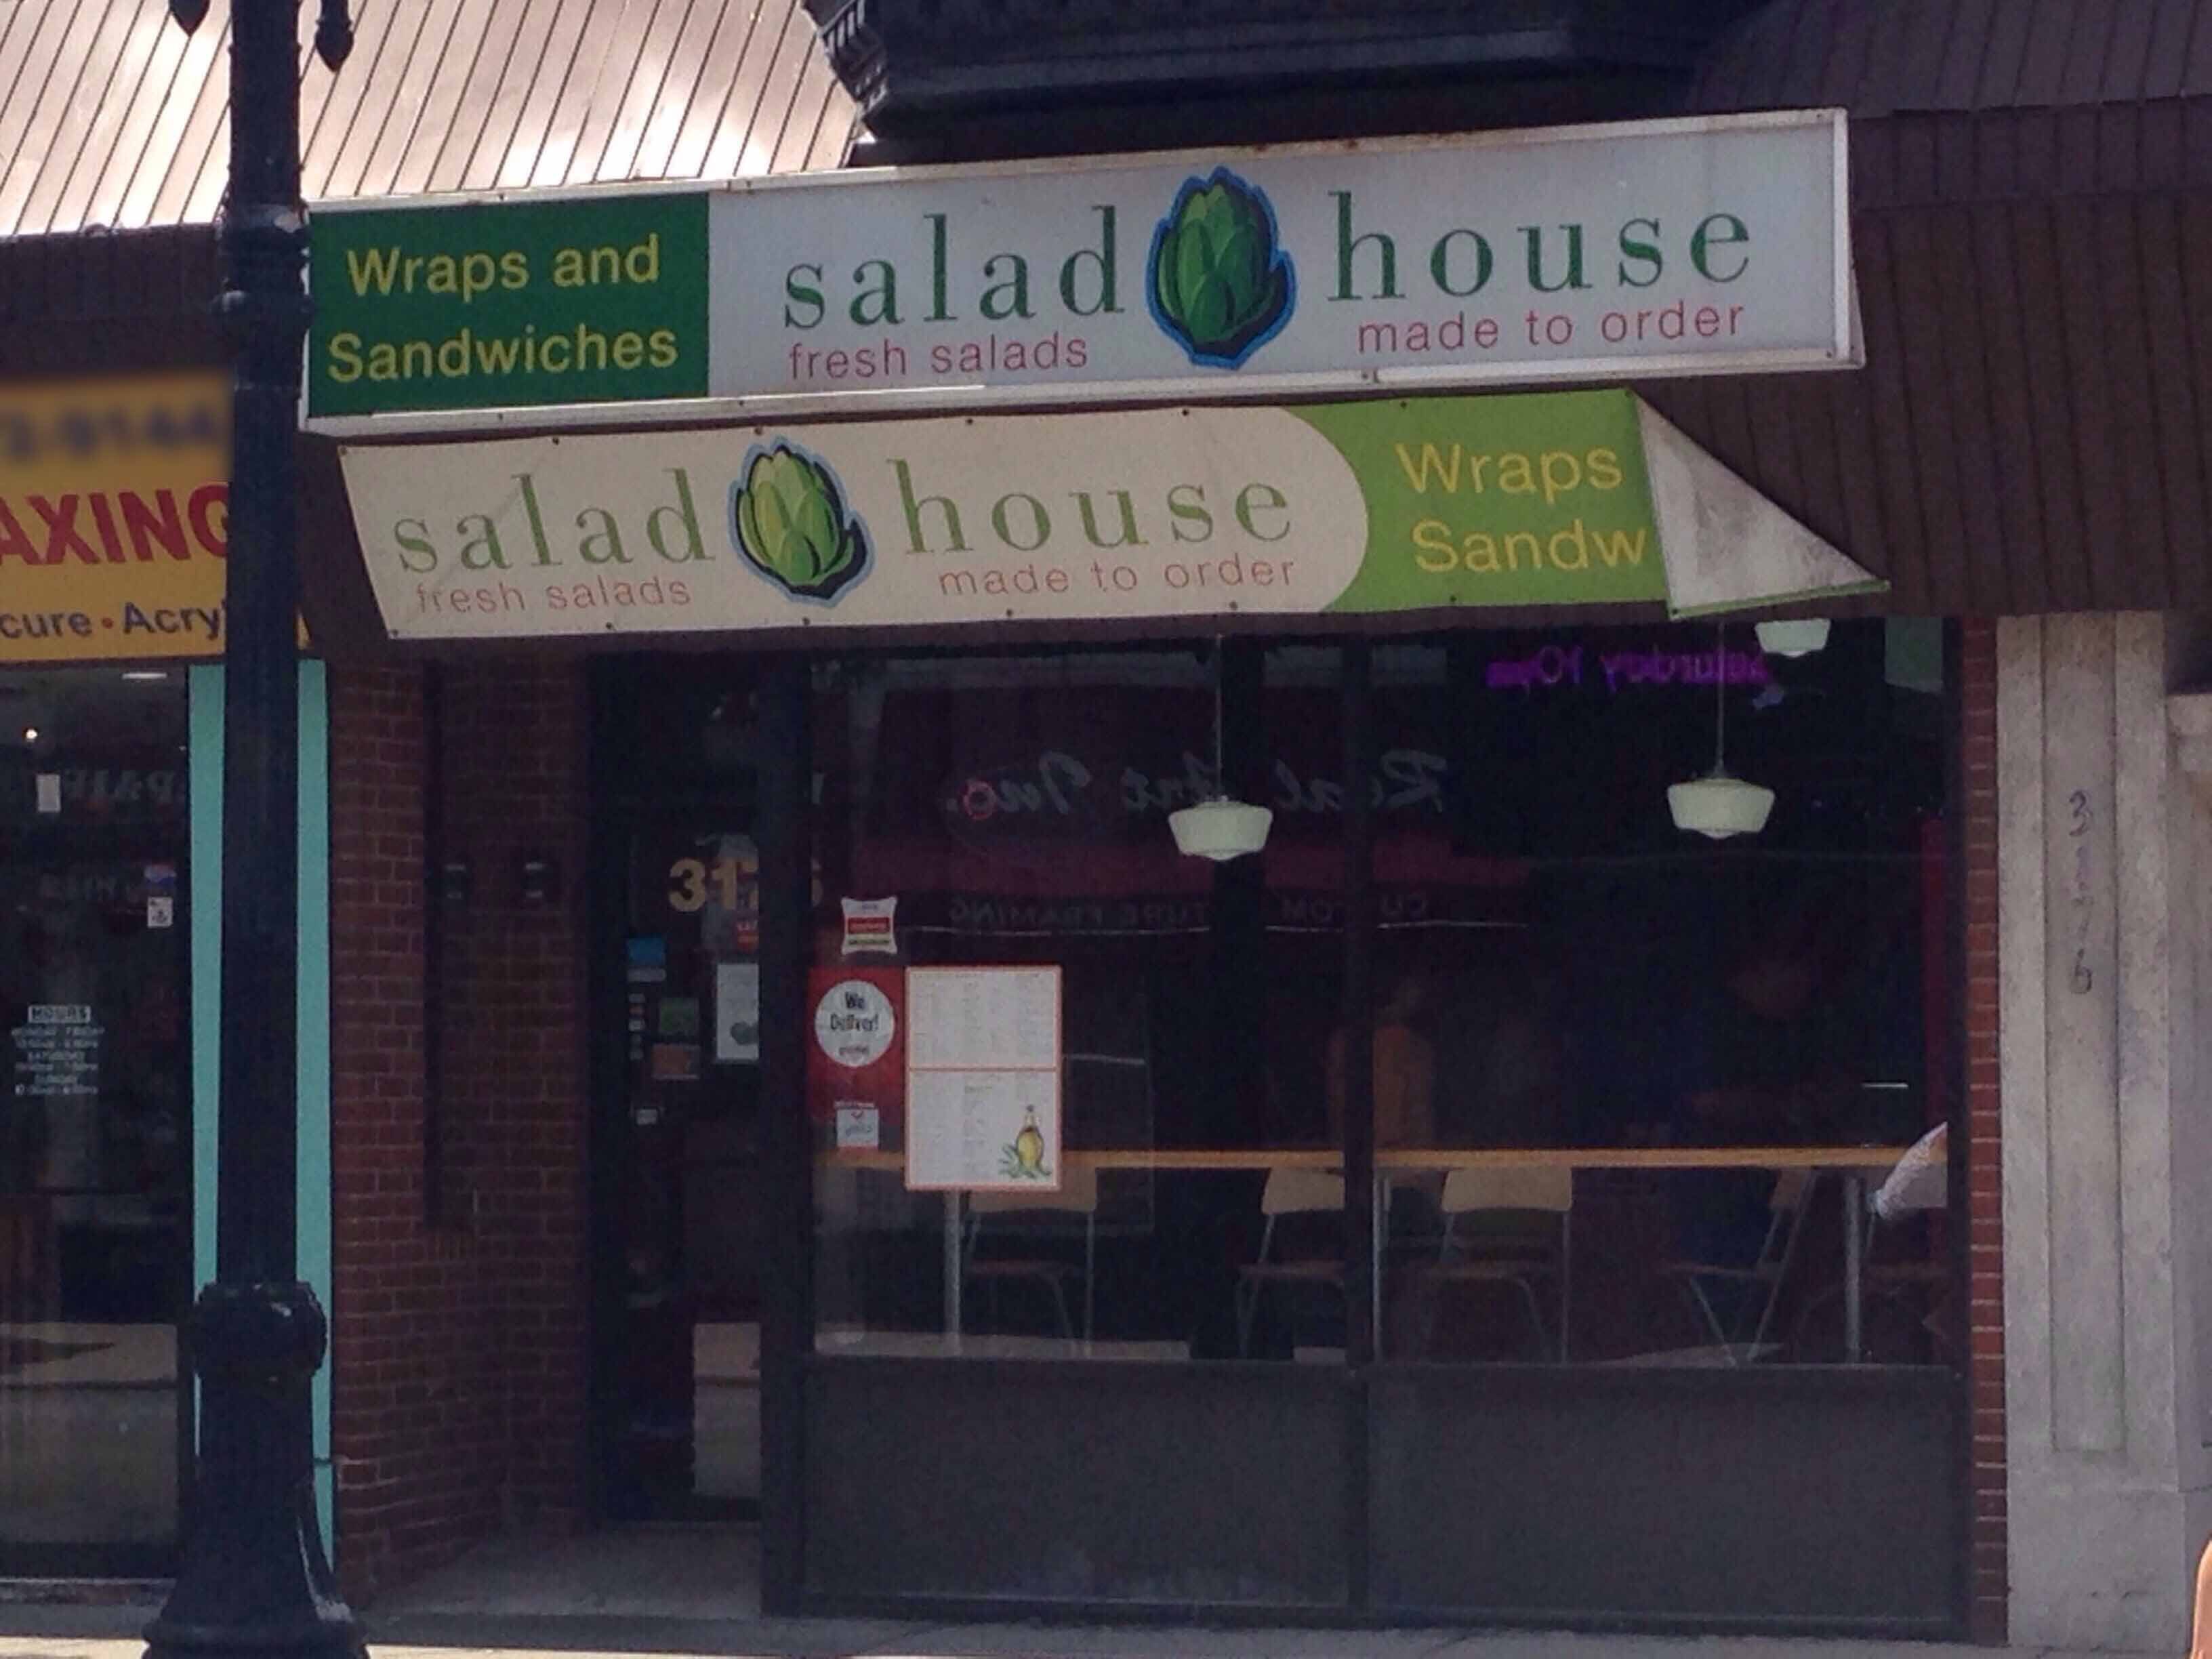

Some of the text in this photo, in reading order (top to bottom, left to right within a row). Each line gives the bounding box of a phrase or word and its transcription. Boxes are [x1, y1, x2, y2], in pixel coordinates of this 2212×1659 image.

[348, 234, 660, 304] Wraps and
[784, 190, 1750, 329] salad house
[328, 323, 678, 384] Sandwiches
[1358, 300, 1745, 354] made to order
[790, 332, 1089, 381] fresh salads
[1396, 443, 1622, 504] Wraps
[392, 457, 1293, 575] salad house
[1412, 518, 1647, 575] Sandw
[415, 575, 692, 613] fresh salads
[939, 552, 1294, 598] made to order
[0, 600, 226, 640] cure Acry
[844, 991, 866, 1010] We
